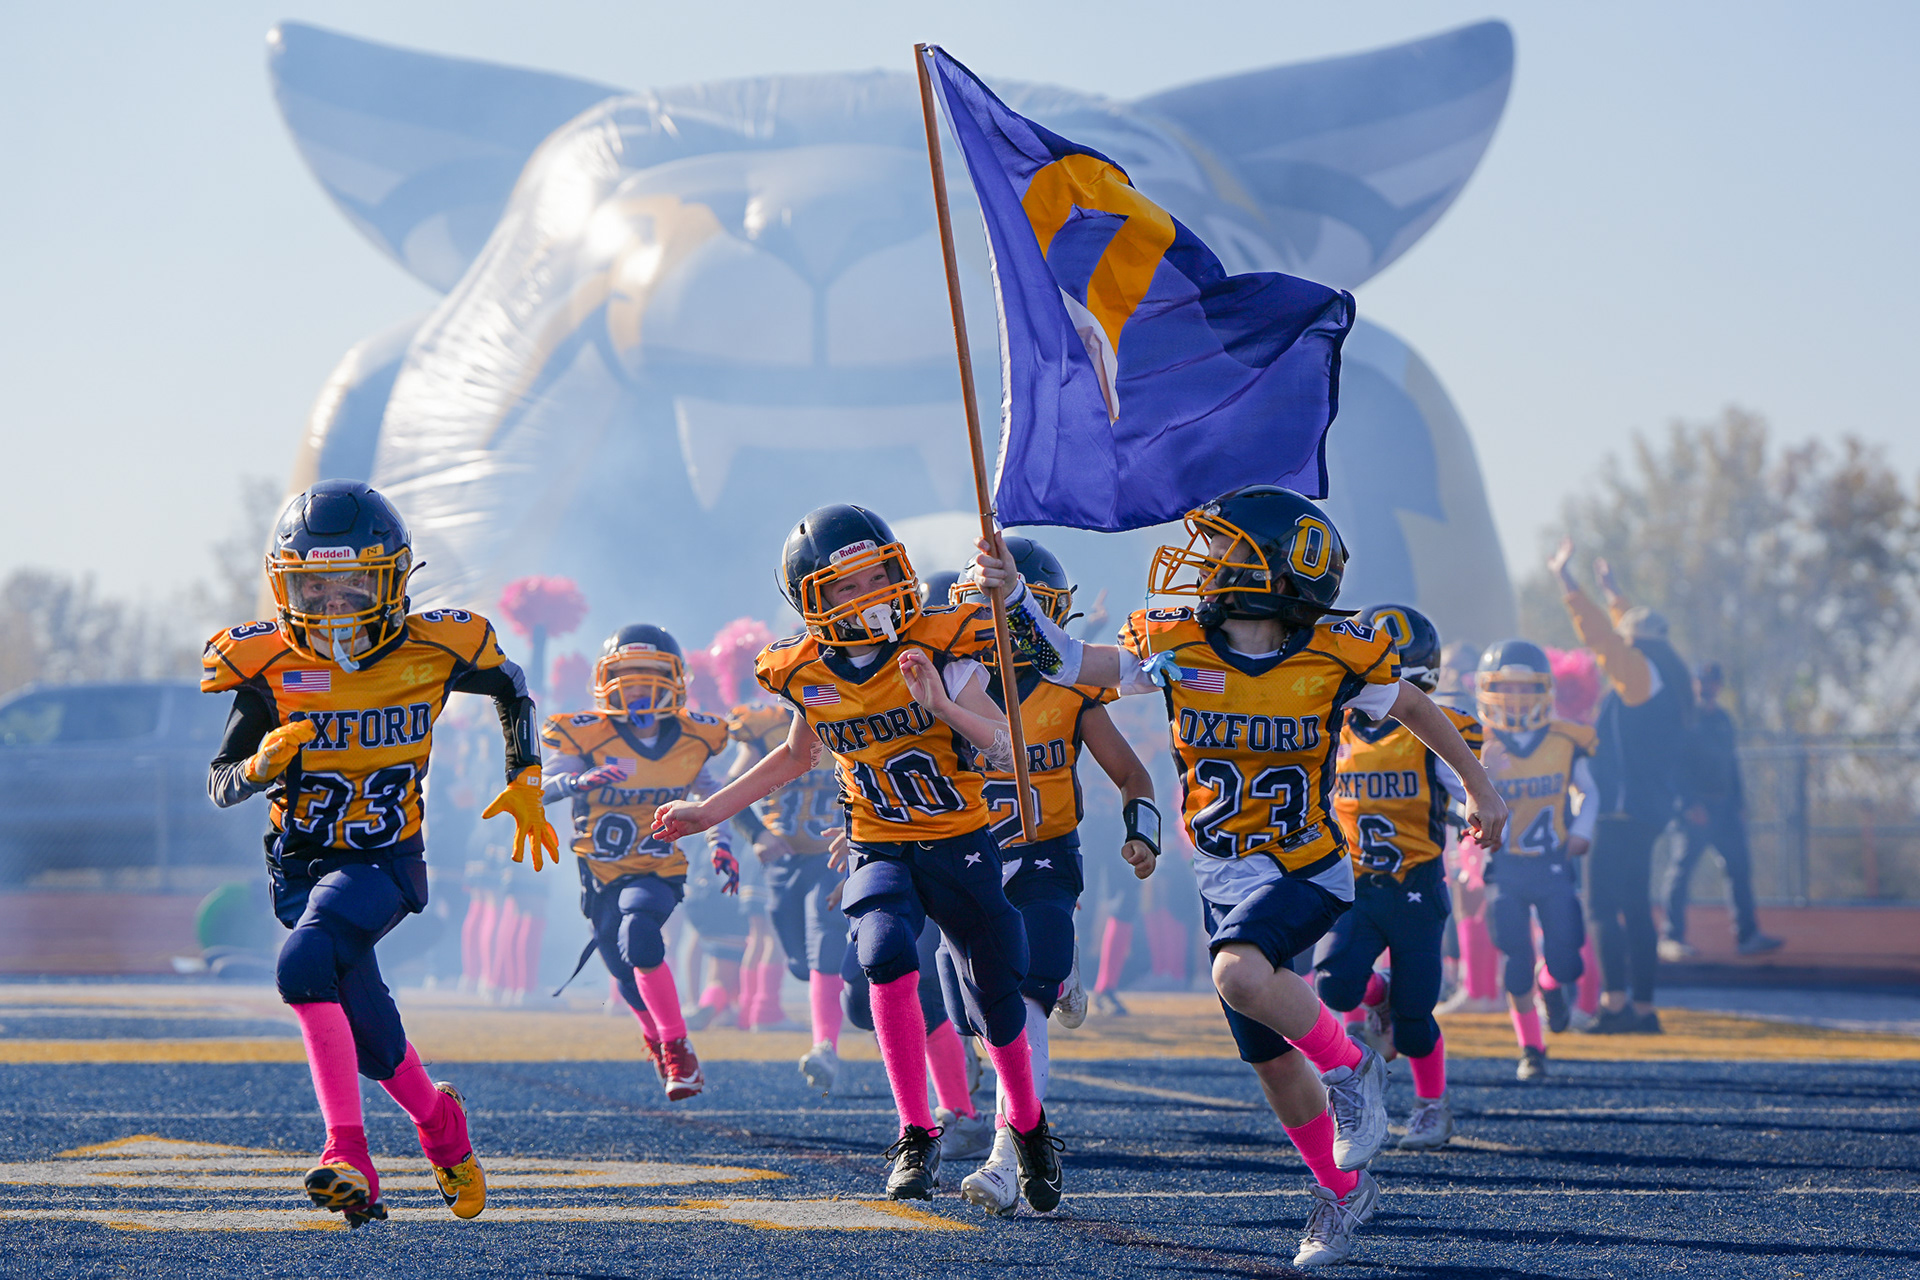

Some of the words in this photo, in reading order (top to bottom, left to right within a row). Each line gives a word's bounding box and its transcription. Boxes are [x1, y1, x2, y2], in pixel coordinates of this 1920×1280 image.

[312, 549, 350, 559] Riddell
[839, 542, 866, 558] Riddell
[1287, 513, 1333, 582] O
[401, 663, 434, 685] 42
[1290, 675, 1325, 696] 42
[815, 700, 936, 755] OXFORD
[1179, 707, 1321, 753] OXFORD
[850, 747, 967, 823] 10
[1190, 758, 1310, 860] 23
[1357, 813, 1404, 874] 6
